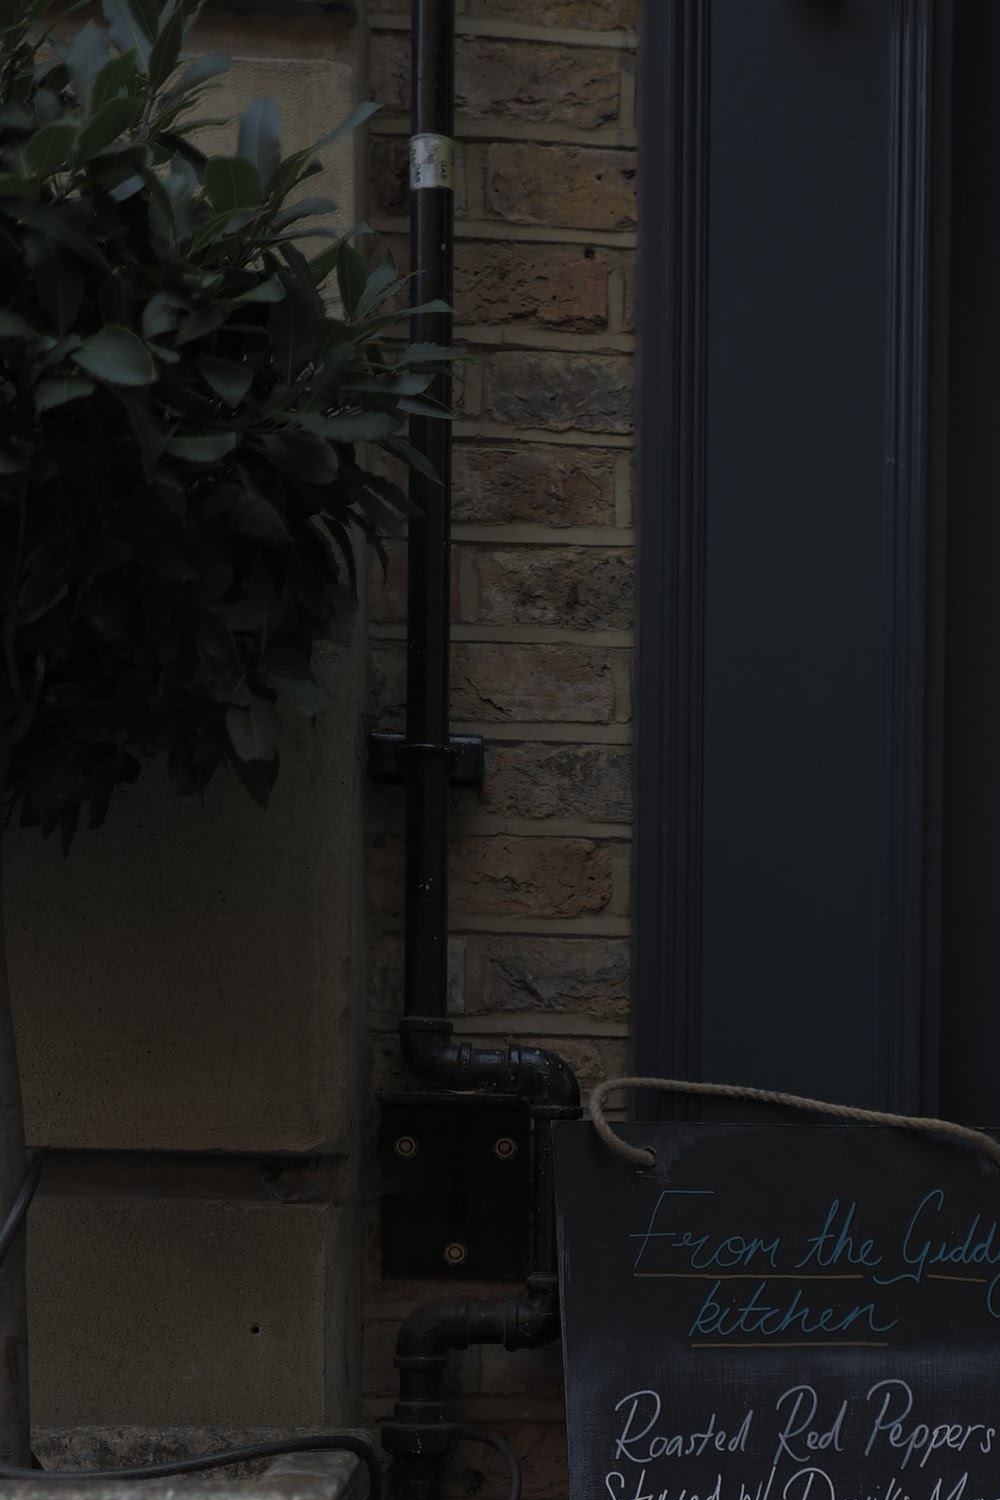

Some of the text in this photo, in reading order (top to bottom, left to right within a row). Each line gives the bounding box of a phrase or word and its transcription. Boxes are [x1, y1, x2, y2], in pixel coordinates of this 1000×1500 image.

[628, 1189, 782, 1270] From
[795, 1197, 884, 1269] the
[687, 1279, 900, 1337] kitchen
[614, 1378, 996, 1471] Roasted Red Peppers
